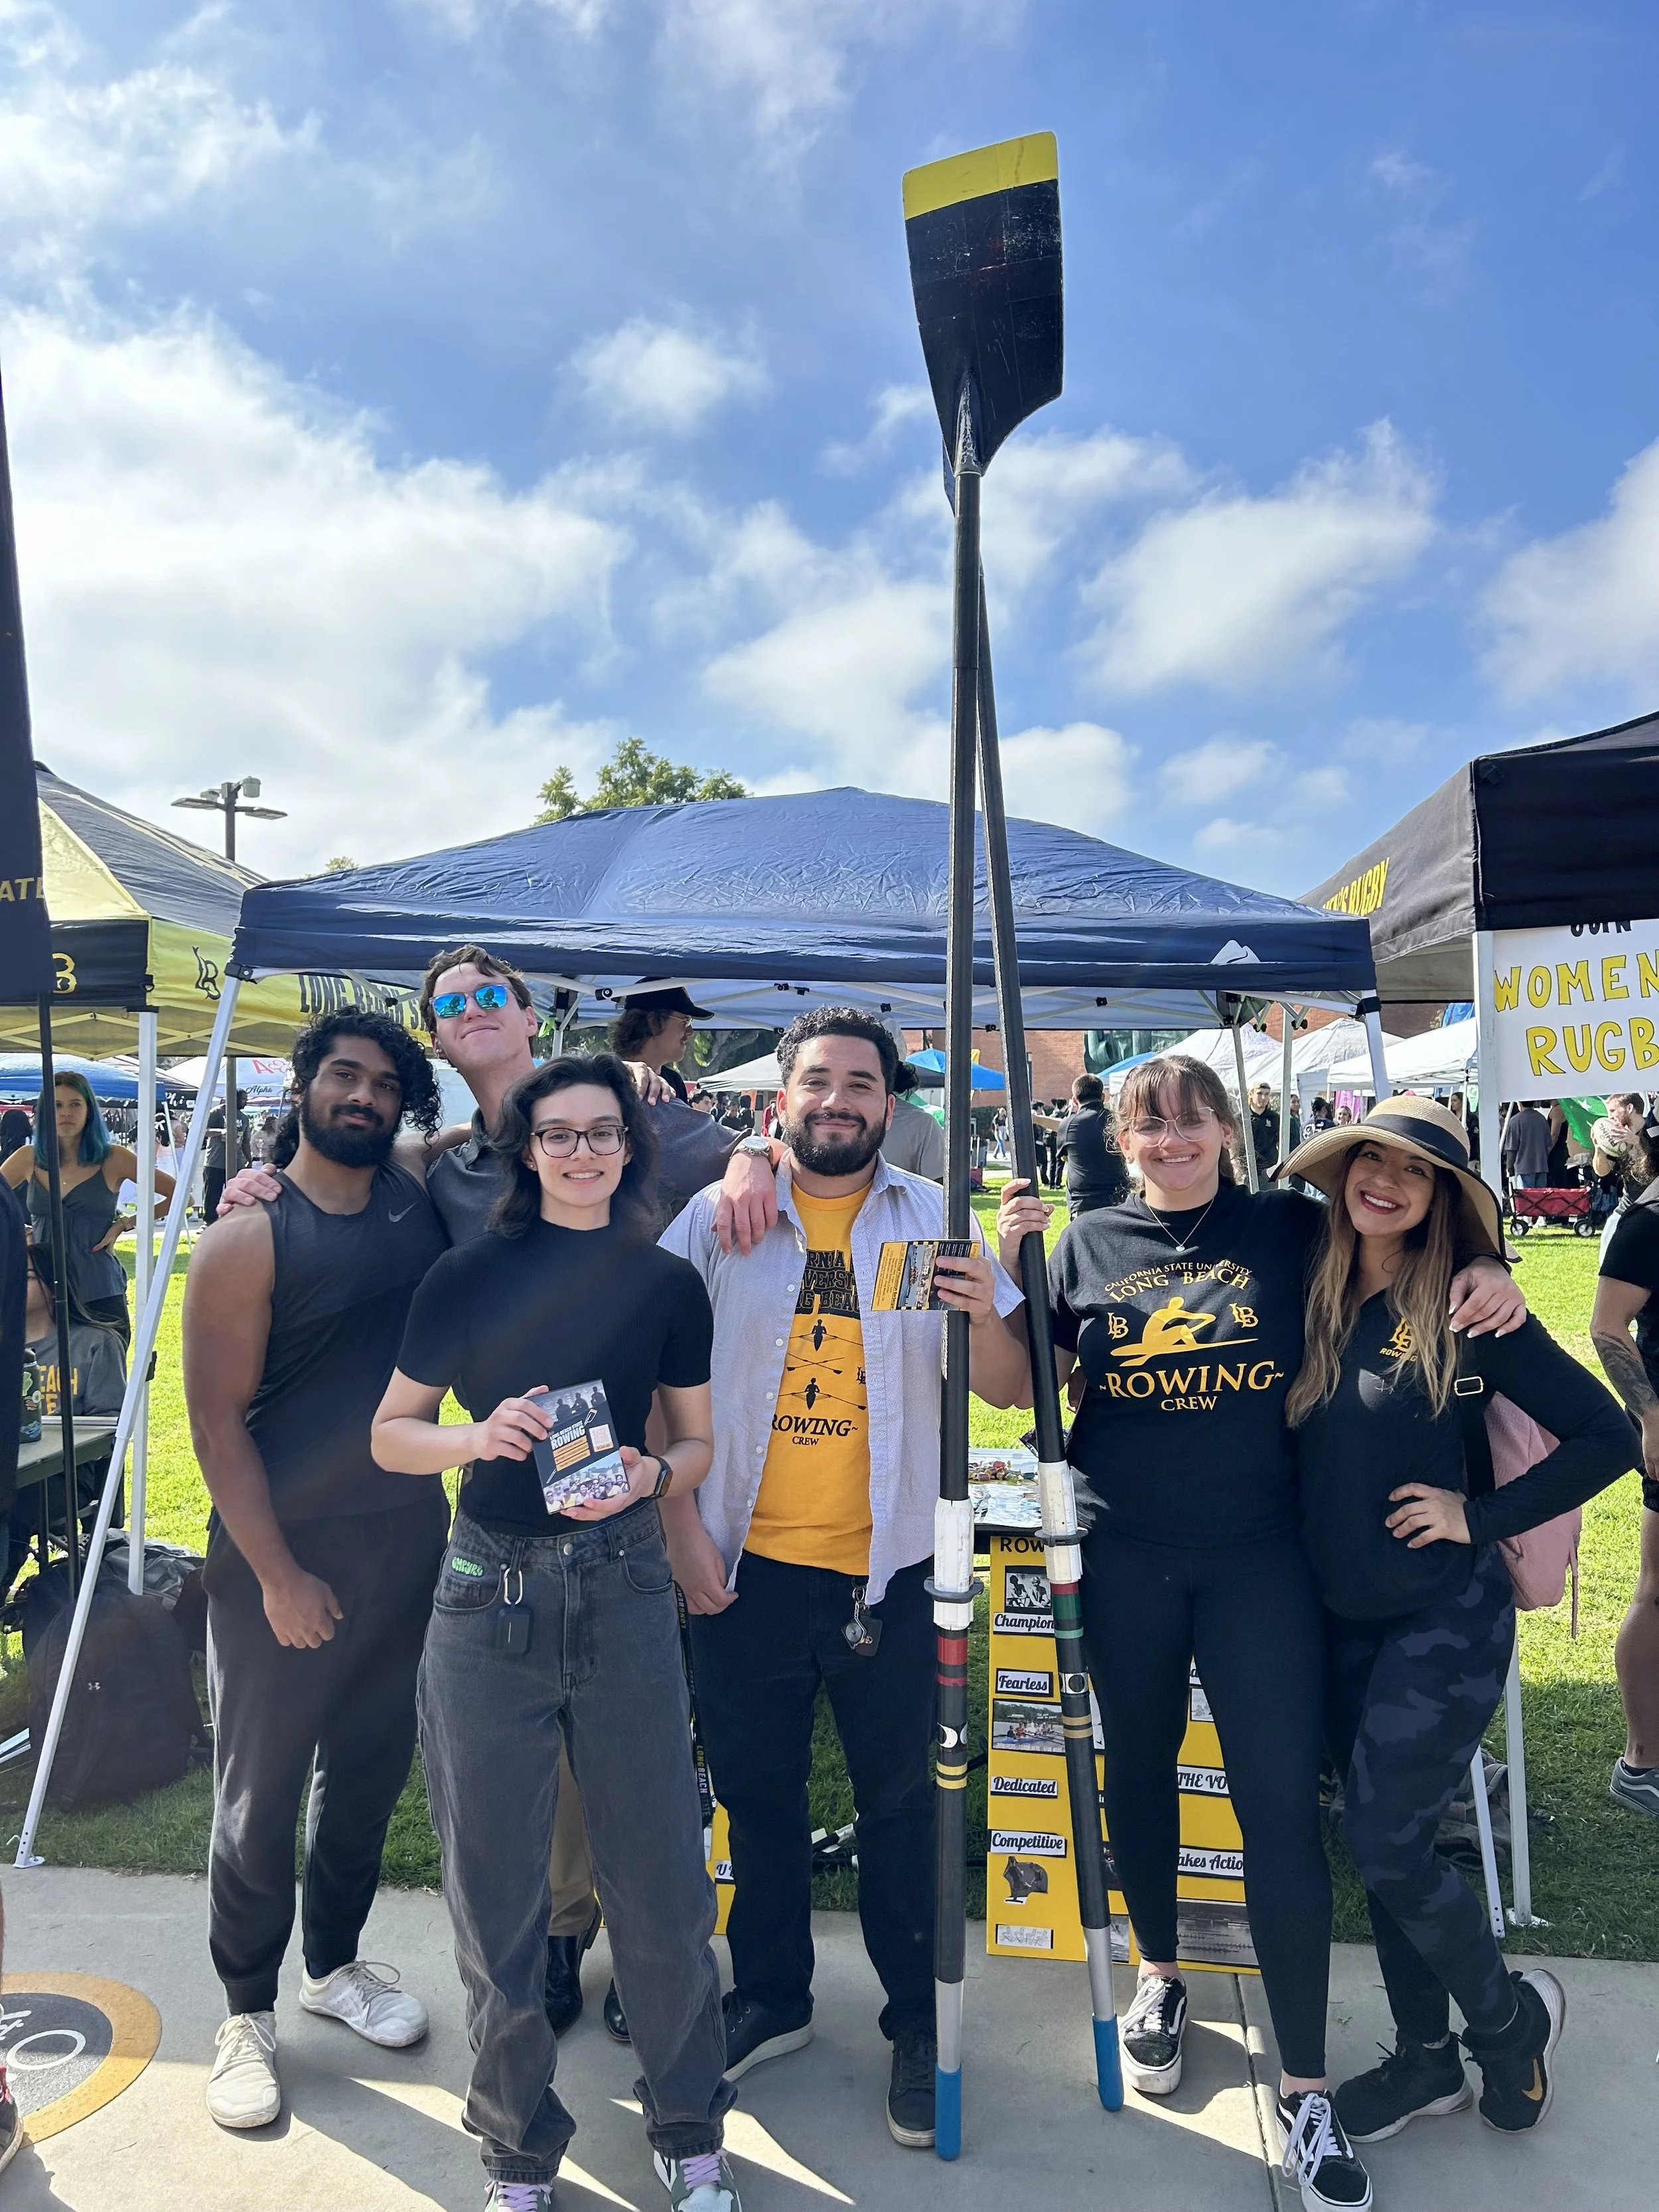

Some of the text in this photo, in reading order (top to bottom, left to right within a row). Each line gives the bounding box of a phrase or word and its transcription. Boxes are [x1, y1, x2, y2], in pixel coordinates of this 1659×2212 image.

[1348, 857, 1390, 917] RUGBY
[299, 974, 348, 1015] LONG
[1104, 1267, 1163, 1291] CALIFORNIA
[1164, 1262, 1193, 1273] STATE
[1110, 1267, 1250, 1302] LONG BEACH
[1161, 1396, 1218, 1411] CREW
[550, 1425, 586, 1450] ROWING
[792, 1436, 820, 1446] CREW
[999, 1674, 1048, 1691] Fearless
[697, 1767, 708, 1793] BEACH
[993, 1777, 1056, 1794] Dedicated
[992, 1832, 1063, 1852] Competitive
[1179, 1852, 1206, 1868] akes
